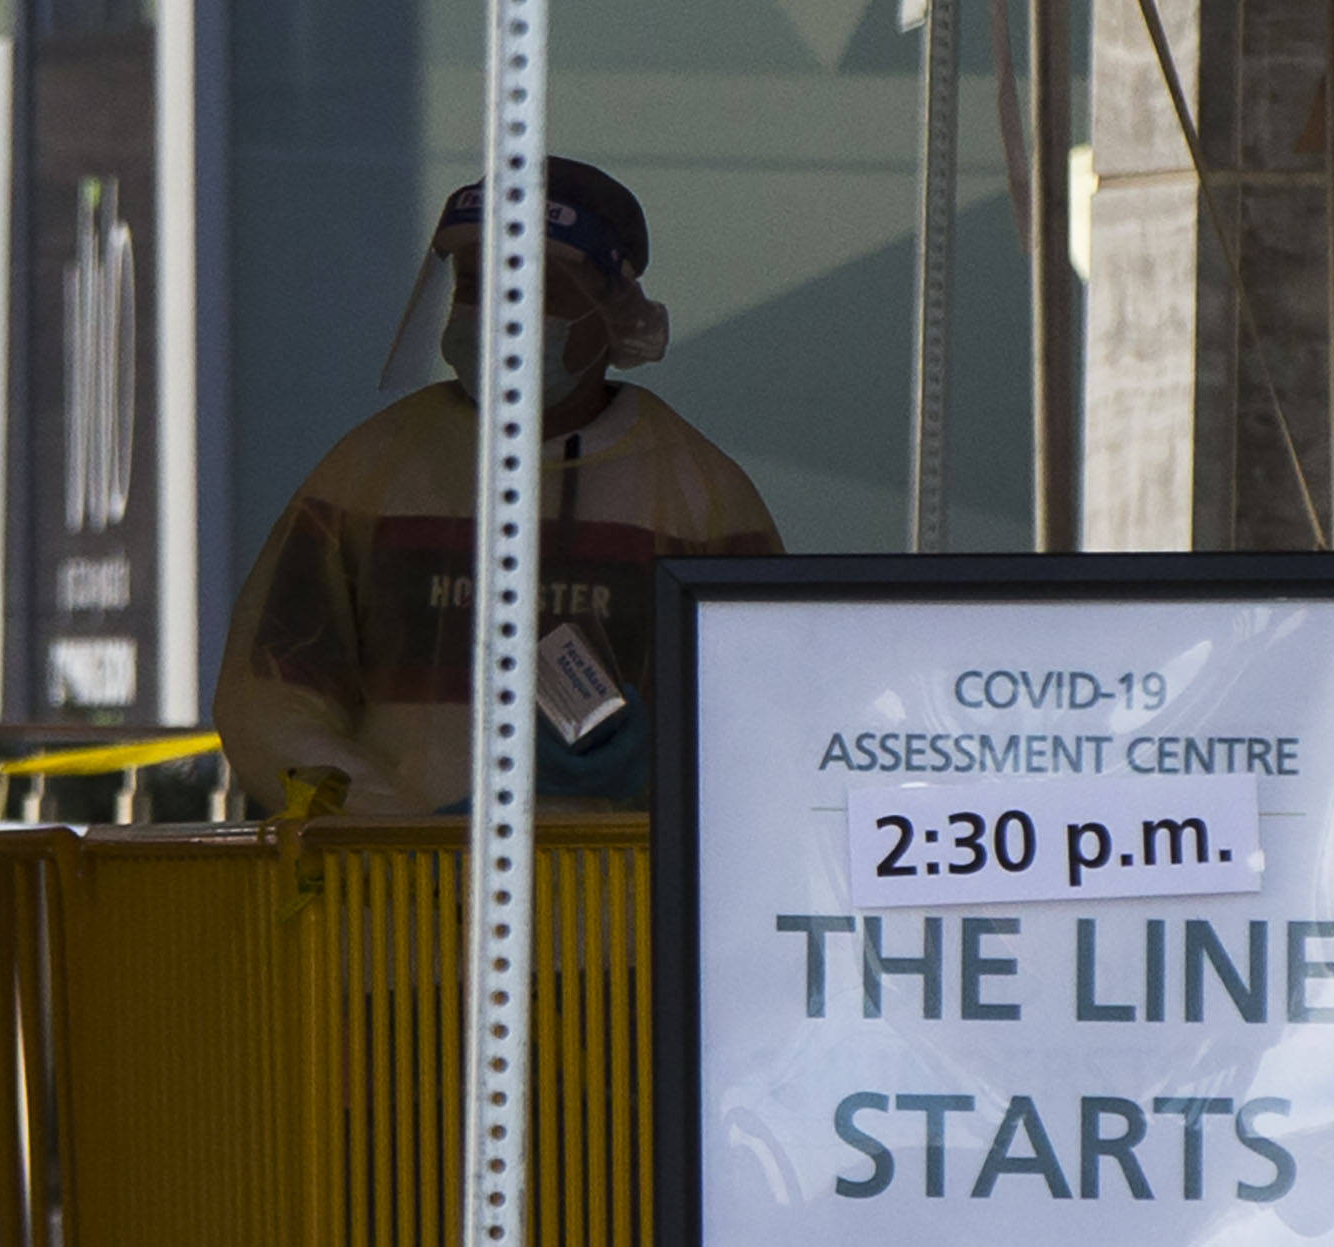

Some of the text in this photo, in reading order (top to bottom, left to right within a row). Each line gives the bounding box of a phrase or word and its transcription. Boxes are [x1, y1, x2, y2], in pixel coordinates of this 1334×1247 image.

[954, 670, 1163, 709] COVID-19
[819, 732, 1298, 775] ASSESSMENT CENTRE
[876, 810, 1231, 887] 2:30 p.m.
[776, 915, 1021, 1021] THE
[834, 1092, 1294, 1201] STARTS
